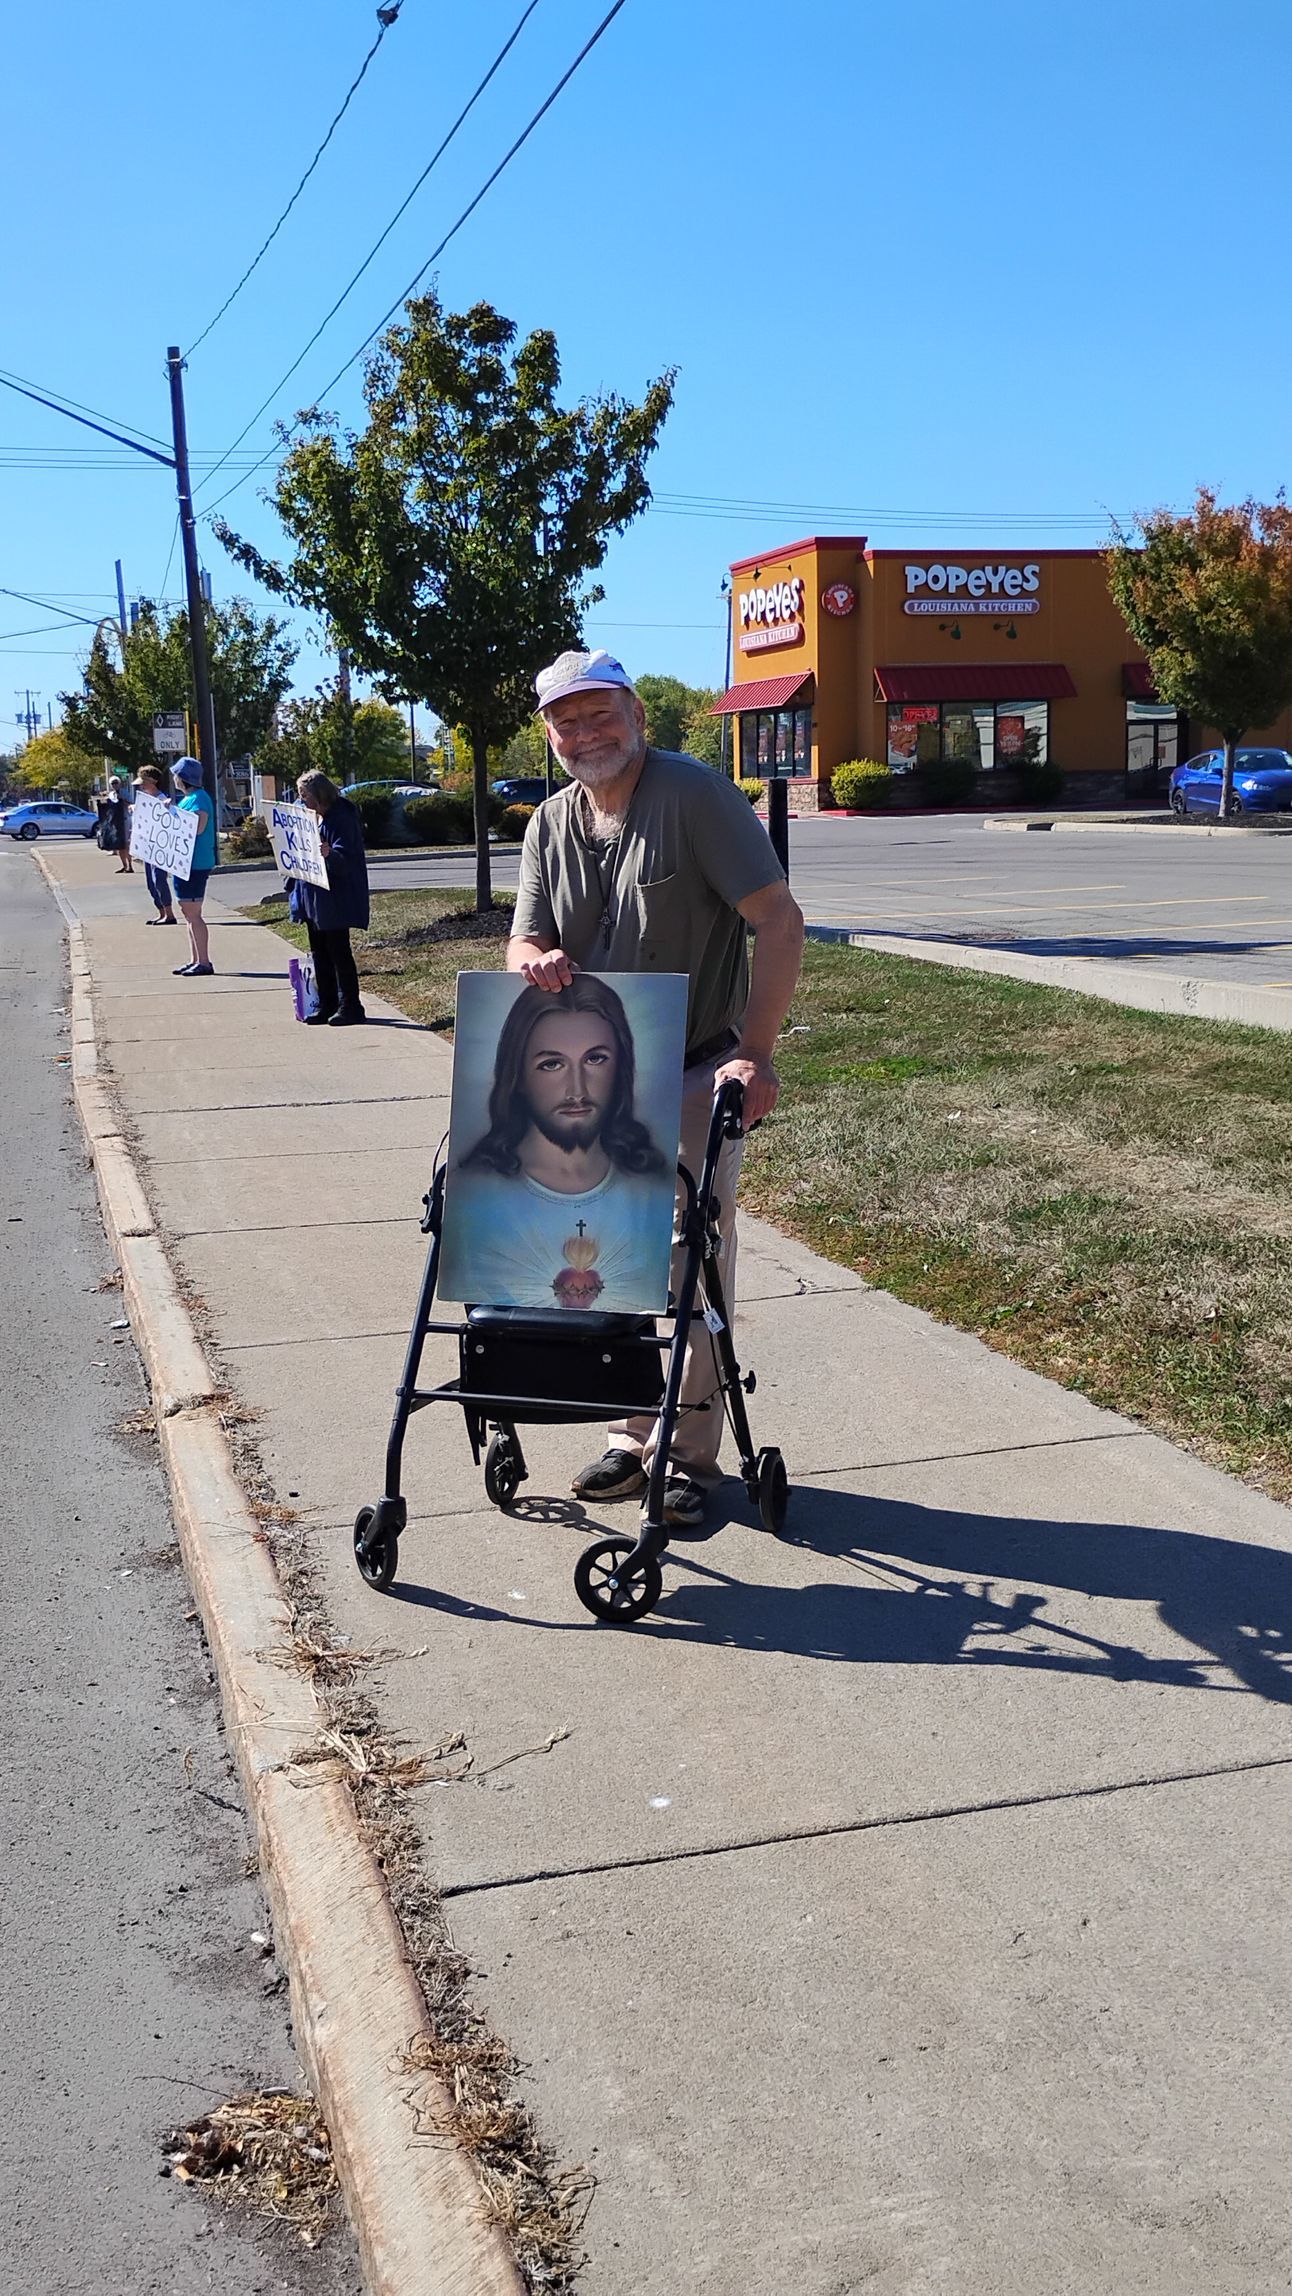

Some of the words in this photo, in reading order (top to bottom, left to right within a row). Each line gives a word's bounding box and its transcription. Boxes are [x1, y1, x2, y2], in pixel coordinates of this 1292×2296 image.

[913, 603, 975, 612] LOUISIANA
[979, 603, 1033, 612] KITCHEN
[160, 741, 179, 749] ONLY
[152, 802, 181, 831] GOD
[149, 825, 189, 856] LOVES
[148, 844, 175, 868] YOU
